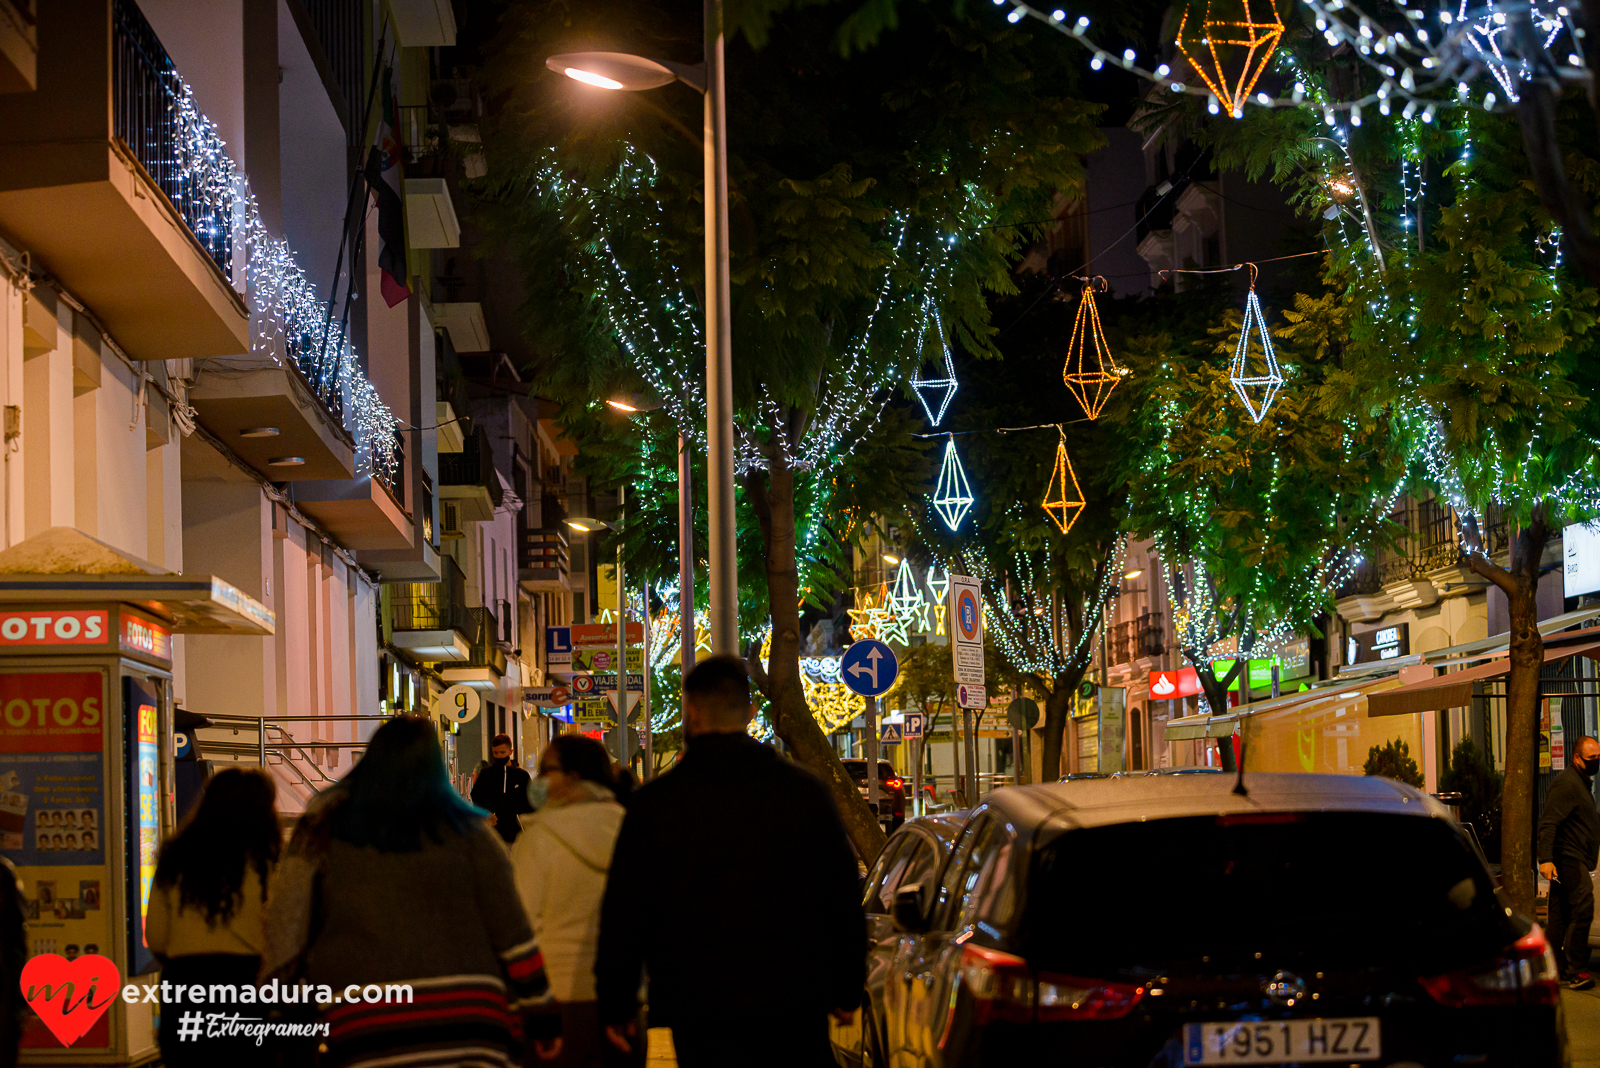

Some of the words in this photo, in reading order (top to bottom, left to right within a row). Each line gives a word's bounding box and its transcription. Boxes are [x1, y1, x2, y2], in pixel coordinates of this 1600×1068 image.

[127, 621, 153, 651] FOTOS
[553, 631, 567, 650] L
[593, 676, 618, 685] VIAJES
[0, 698, 100, 728] OTOS
[575, 702, 587, 717] H
[1216, 1023, 1292, 1057] 1951
[1308, 1022, 1371, 1055] HZZ
